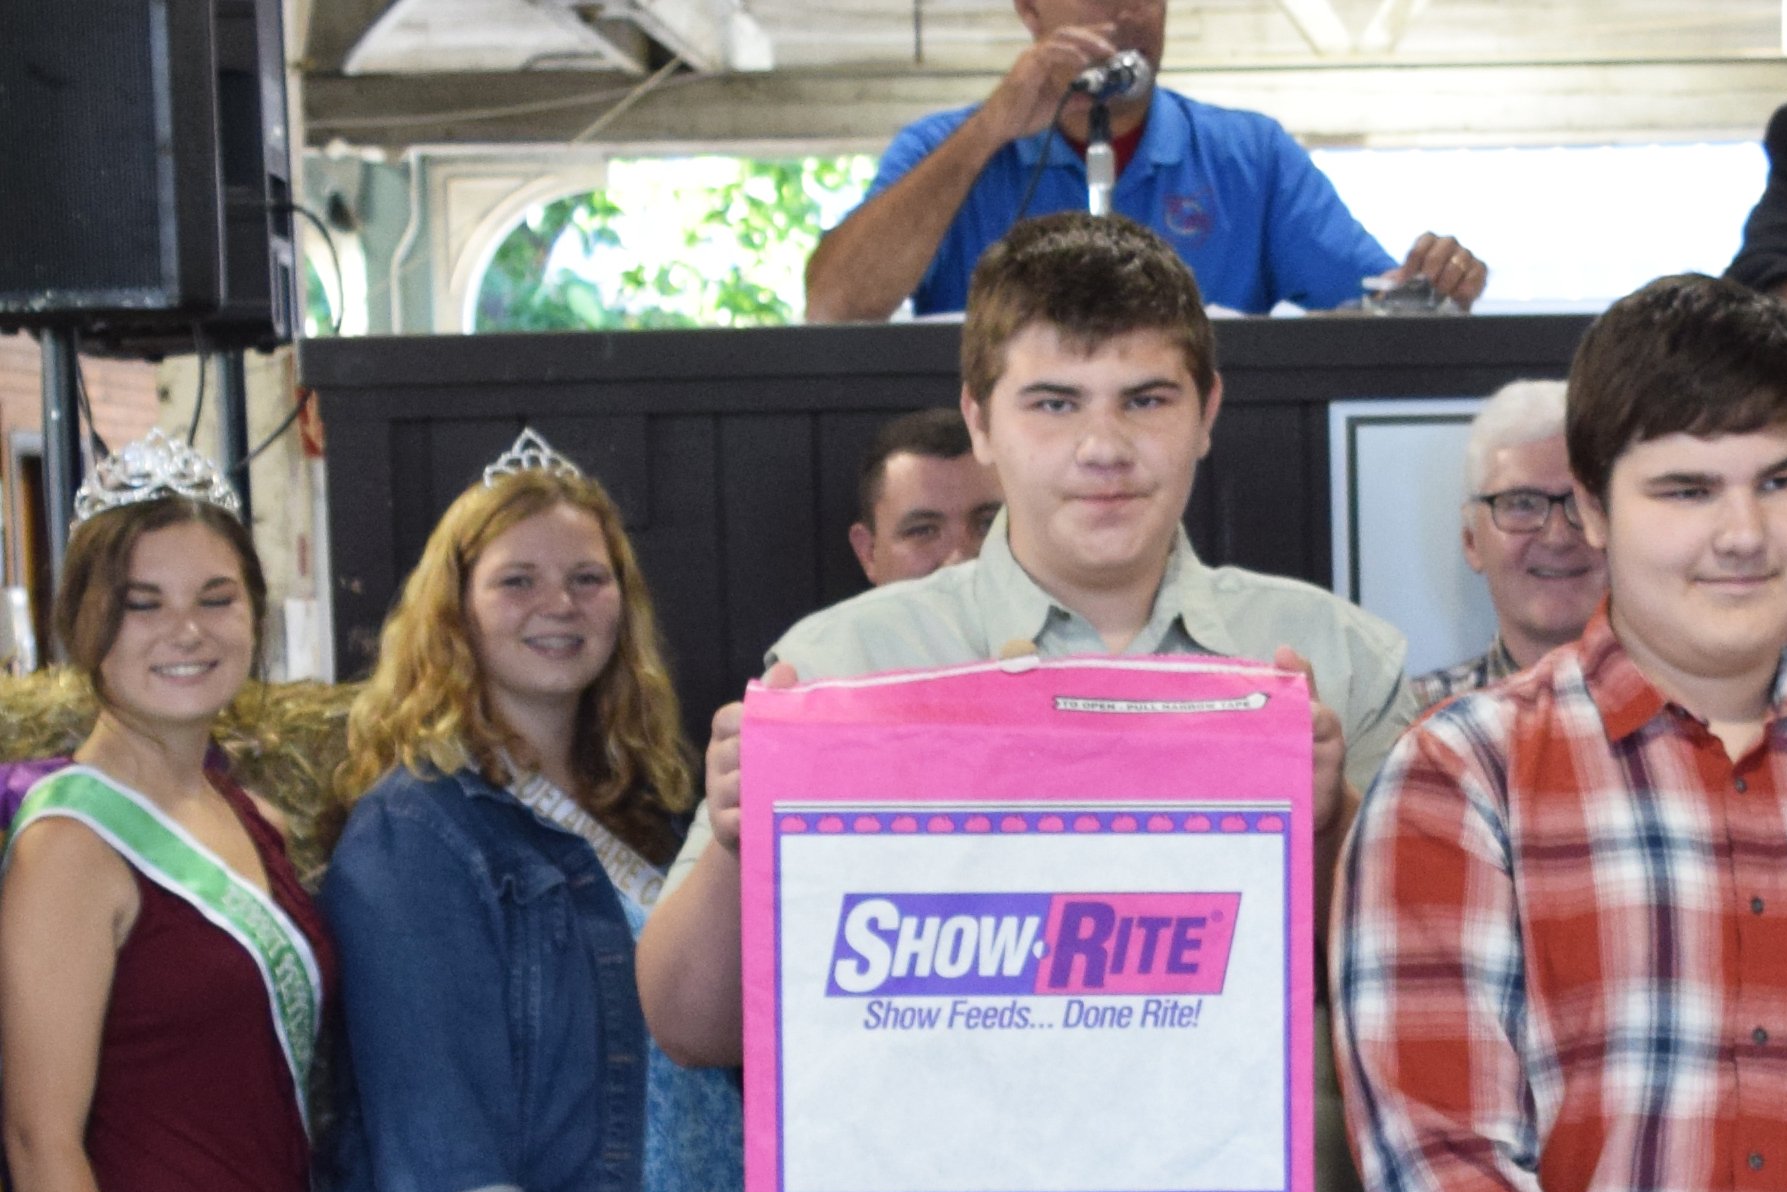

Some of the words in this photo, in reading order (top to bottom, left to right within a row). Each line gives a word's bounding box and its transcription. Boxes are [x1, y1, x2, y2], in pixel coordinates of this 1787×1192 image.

[863, 999, 942, 1030] Show
[947, 999, 1054, 1030] Feeds...
[1062, 1000, 1133, 1029] Done
[1140, 998, 1202, 1028] Rite!
